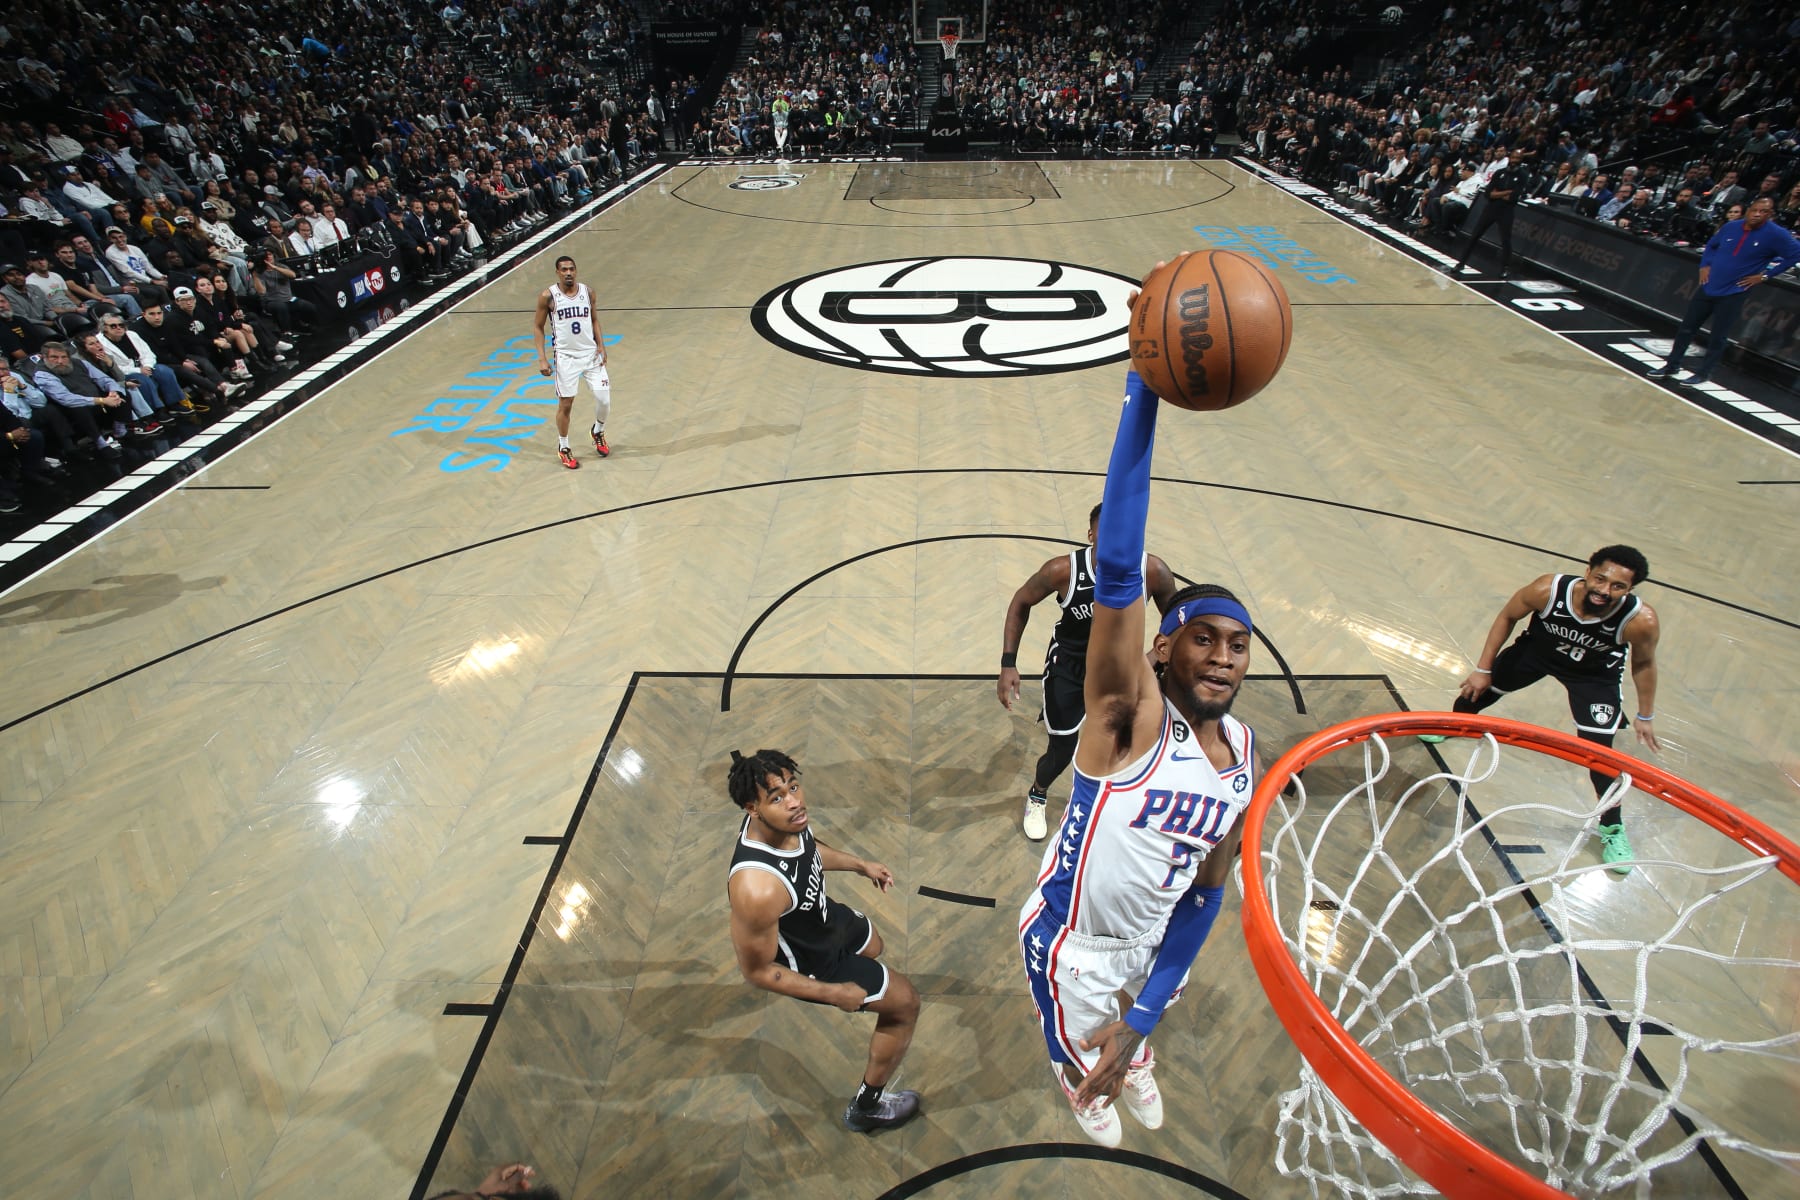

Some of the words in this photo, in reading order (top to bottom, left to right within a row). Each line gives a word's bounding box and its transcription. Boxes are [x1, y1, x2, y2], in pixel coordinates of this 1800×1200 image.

[931, 128, 960, 136] KIA
[678, 157, 820, 166] Brooklyn
[1237, 225, 1357, 284] BARCLAYS
[1553, 235, 1625, 272] EXPRESS
[571, 321, 582, 335] 8
[1178, 283, 1214, 397] Wilson
[388, 335, 538, 438] CENTER
[1078, 572, 1086, 581] 6
[1592, 705, 1614, 715] NETS
[1174, 724, 1186, 741] 6
[1128, 788, 1230, 845] PHIL
[779, 860, 789, 872] 6
[1160, 842, 1202, 889] 7
